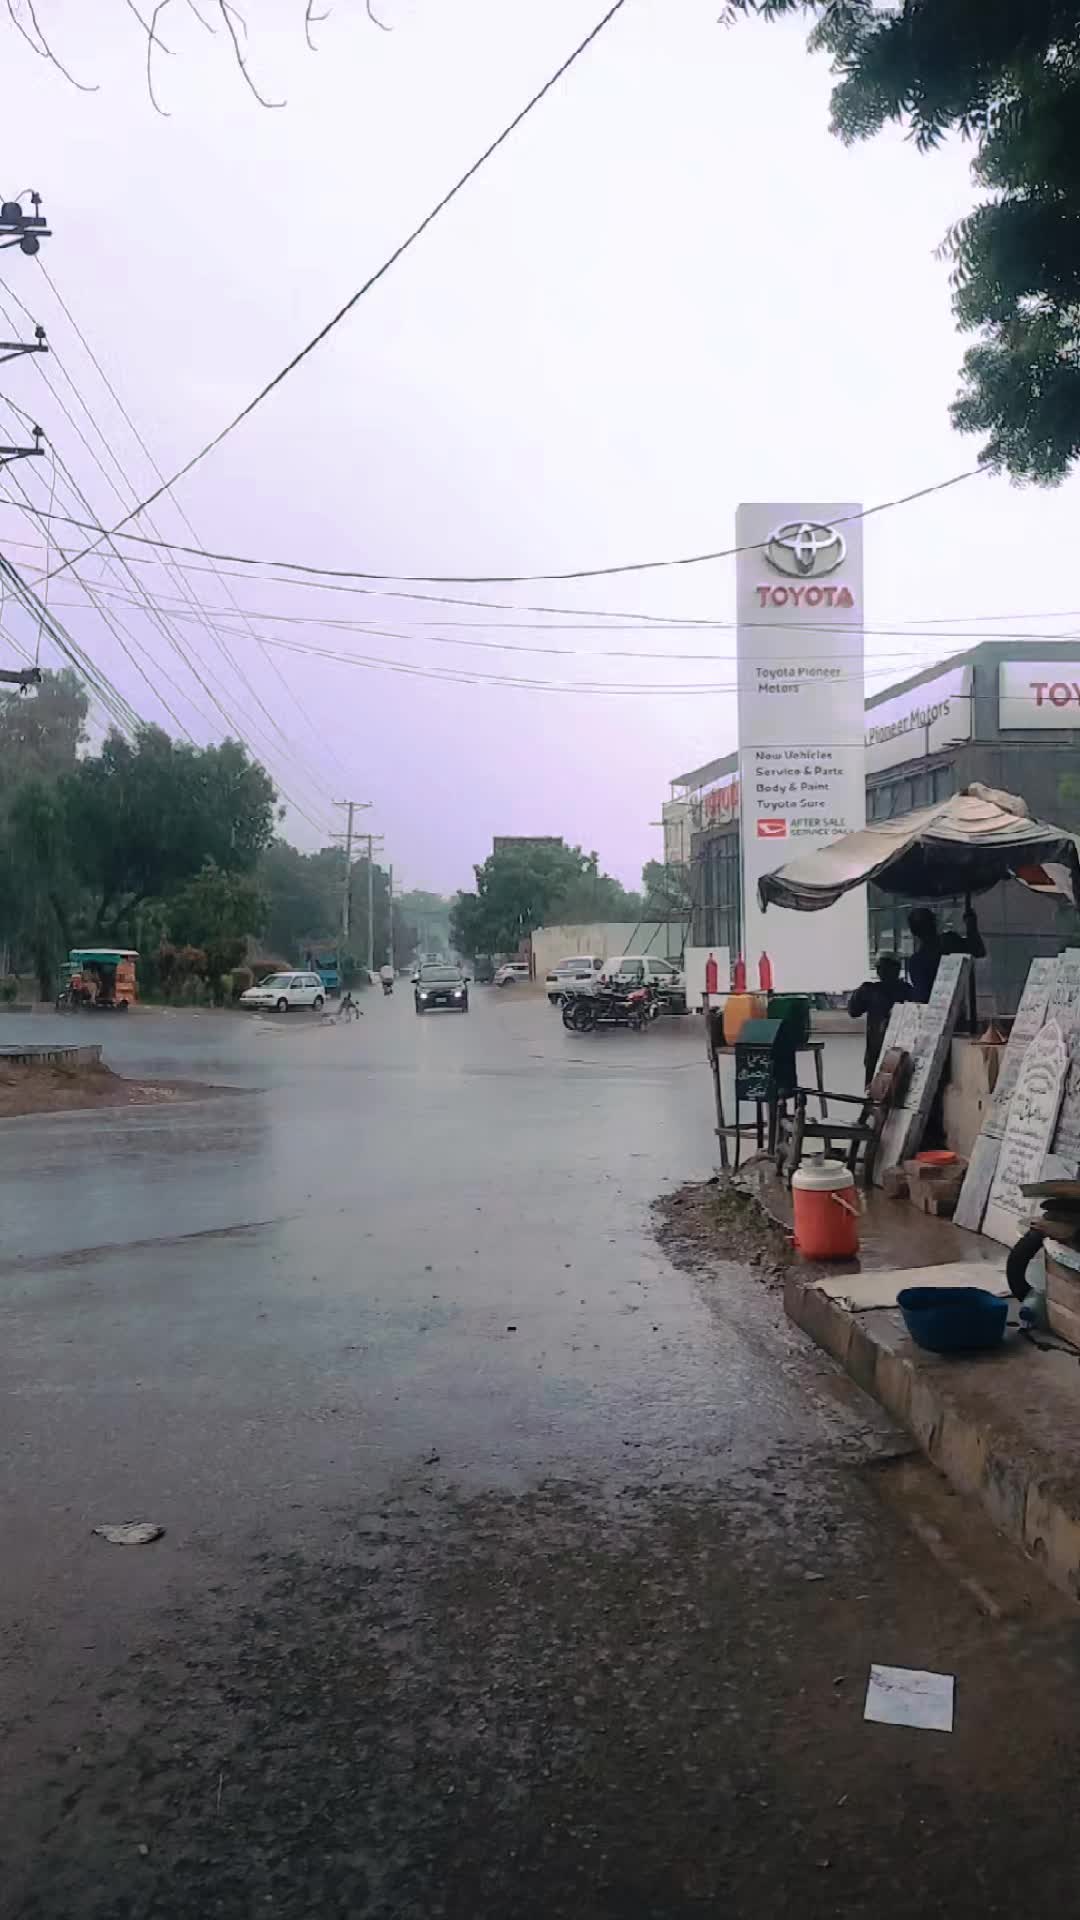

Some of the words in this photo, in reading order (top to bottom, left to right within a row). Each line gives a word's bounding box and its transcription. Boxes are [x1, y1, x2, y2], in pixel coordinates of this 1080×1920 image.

[756, 586, 854, 608] TOYOTA
[756, 667, 795, 679] Toyota
[797, 667, 841, 677] Pioneer
[758, 683, 799, 693] Motors
[869, 717, 908, 744] Pioneer
[910, 699, 950, 728] Motors
[784, 750, 832, 760] Vehicles
[756, 767, 801, 776] Service
[804, 766, 812, 775] &
[814, 766, 844, 775] Parts
[756, 784, 786, 794] Body
[789, 782, 797, 791] &
[801, 782, 830, 791] Paint
[757, 800, 797, 811] Toyota
[791, 818, 821, 827] AFTER
